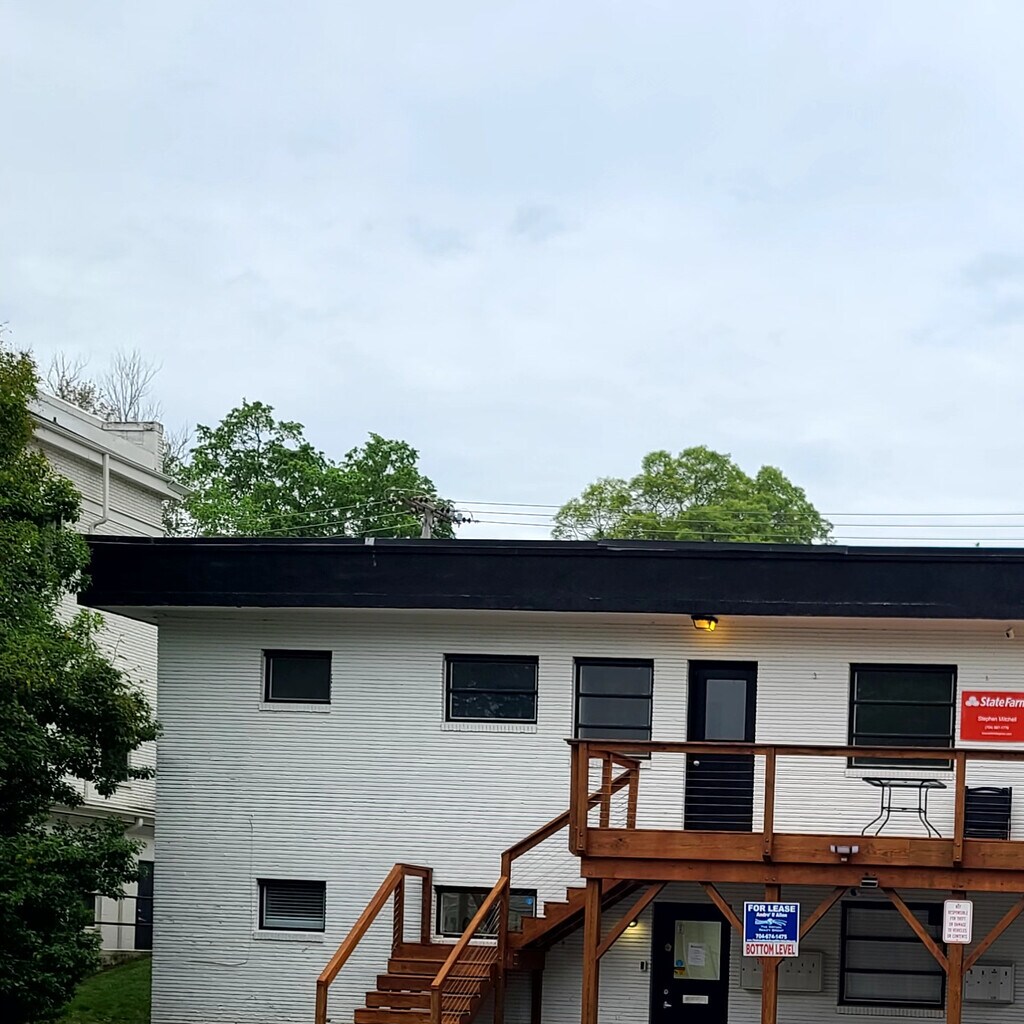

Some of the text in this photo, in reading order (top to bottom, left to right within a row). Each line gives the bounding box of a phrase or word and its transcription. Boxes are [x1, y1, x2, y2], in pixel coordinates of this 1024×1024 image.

[748, 904, 766, 912] FOR
[746, 944, 795, 955] BOTTOM LEVEL
